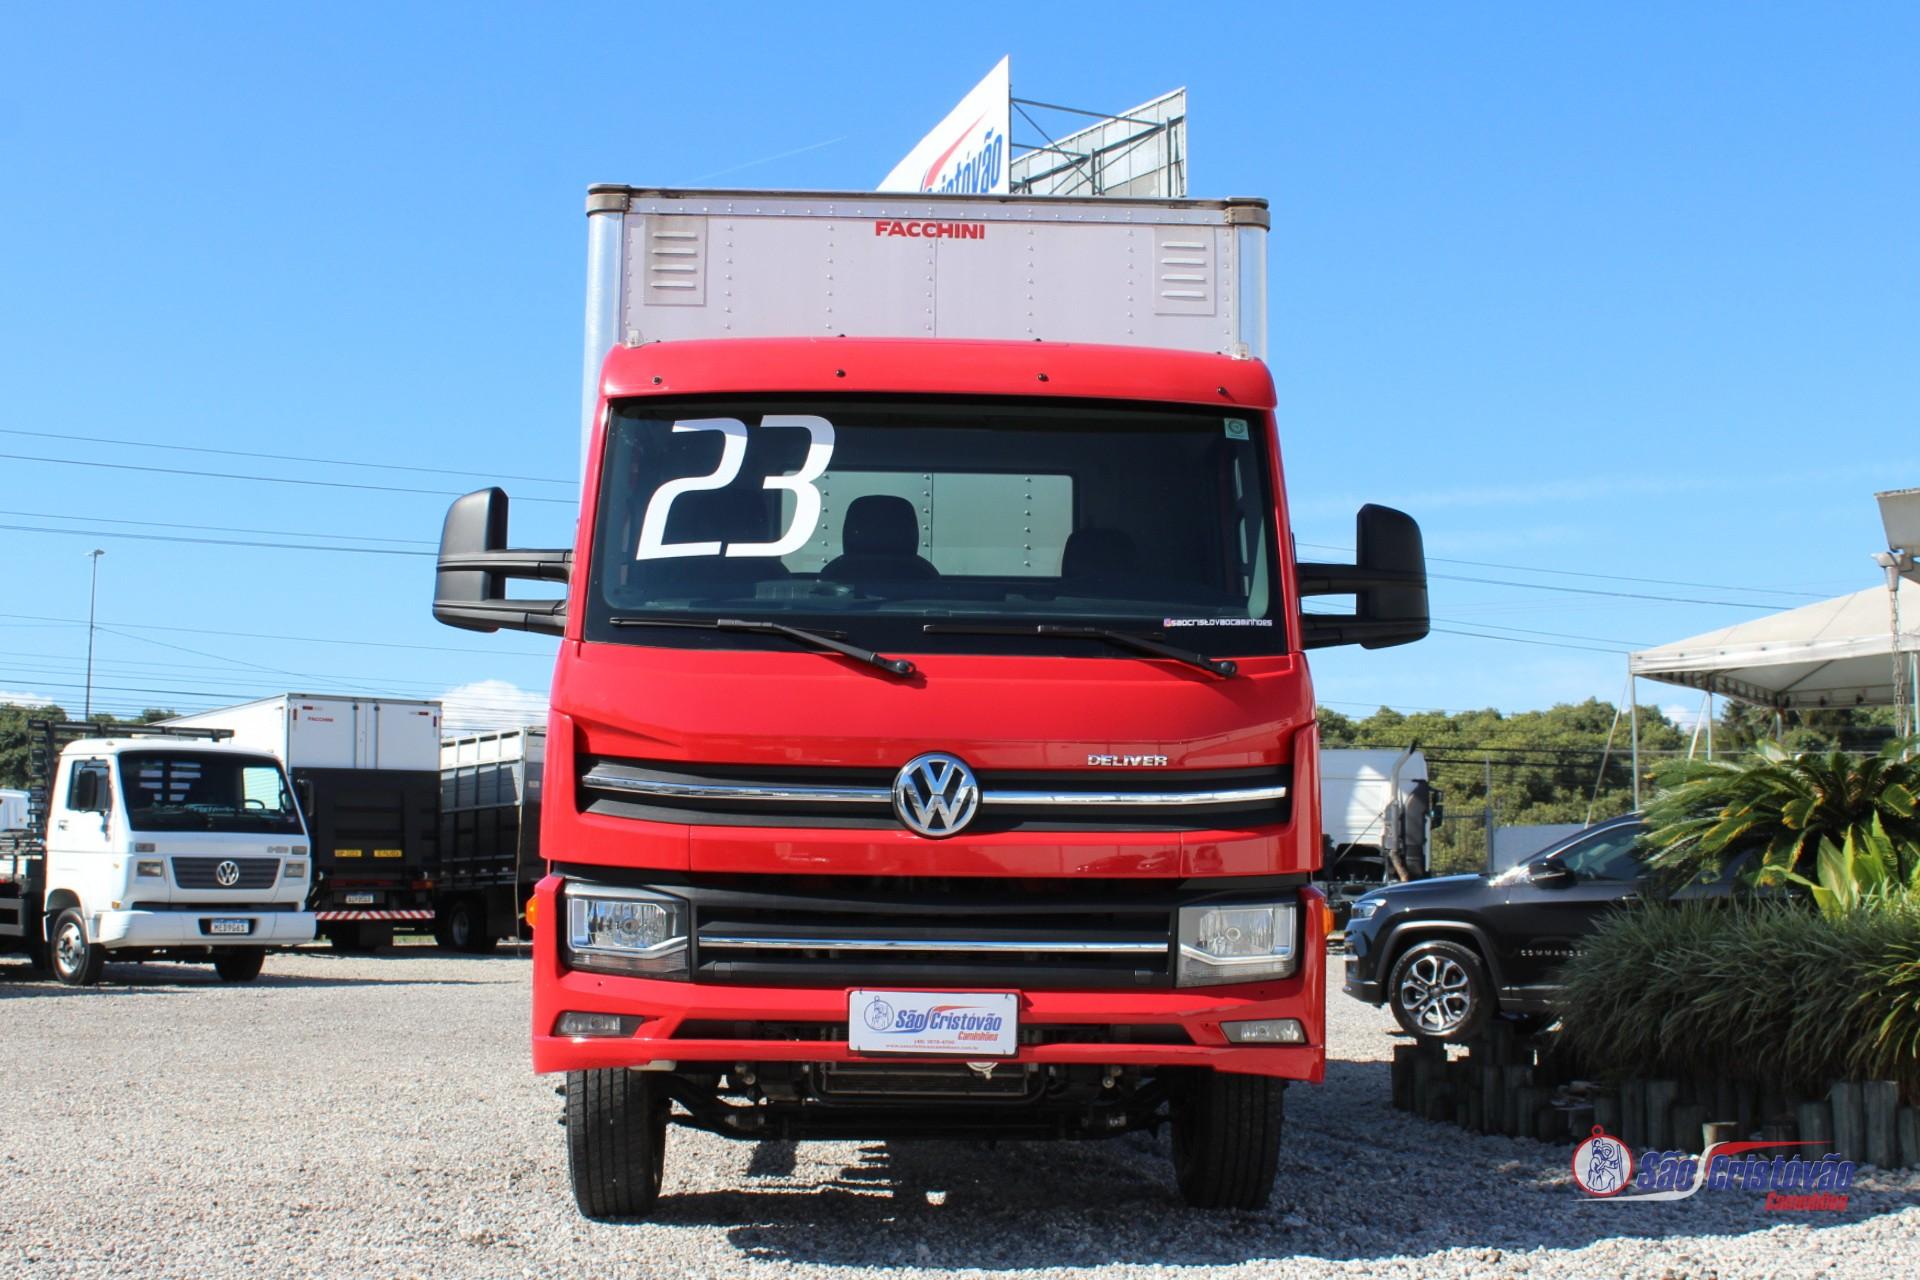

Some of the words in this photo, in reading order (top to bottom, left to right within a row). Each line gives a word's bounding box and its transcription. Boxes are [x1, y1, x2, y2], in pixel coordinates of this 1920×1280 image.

[875, 221, 985, 239] FACCHINI
[636, 415, 836, 560] 23
[1087, 754, 1168, 767] DELIVER
[895, 1009, 925, 1029] São
[930, 1012, 1003, 1031] Cristóvão
